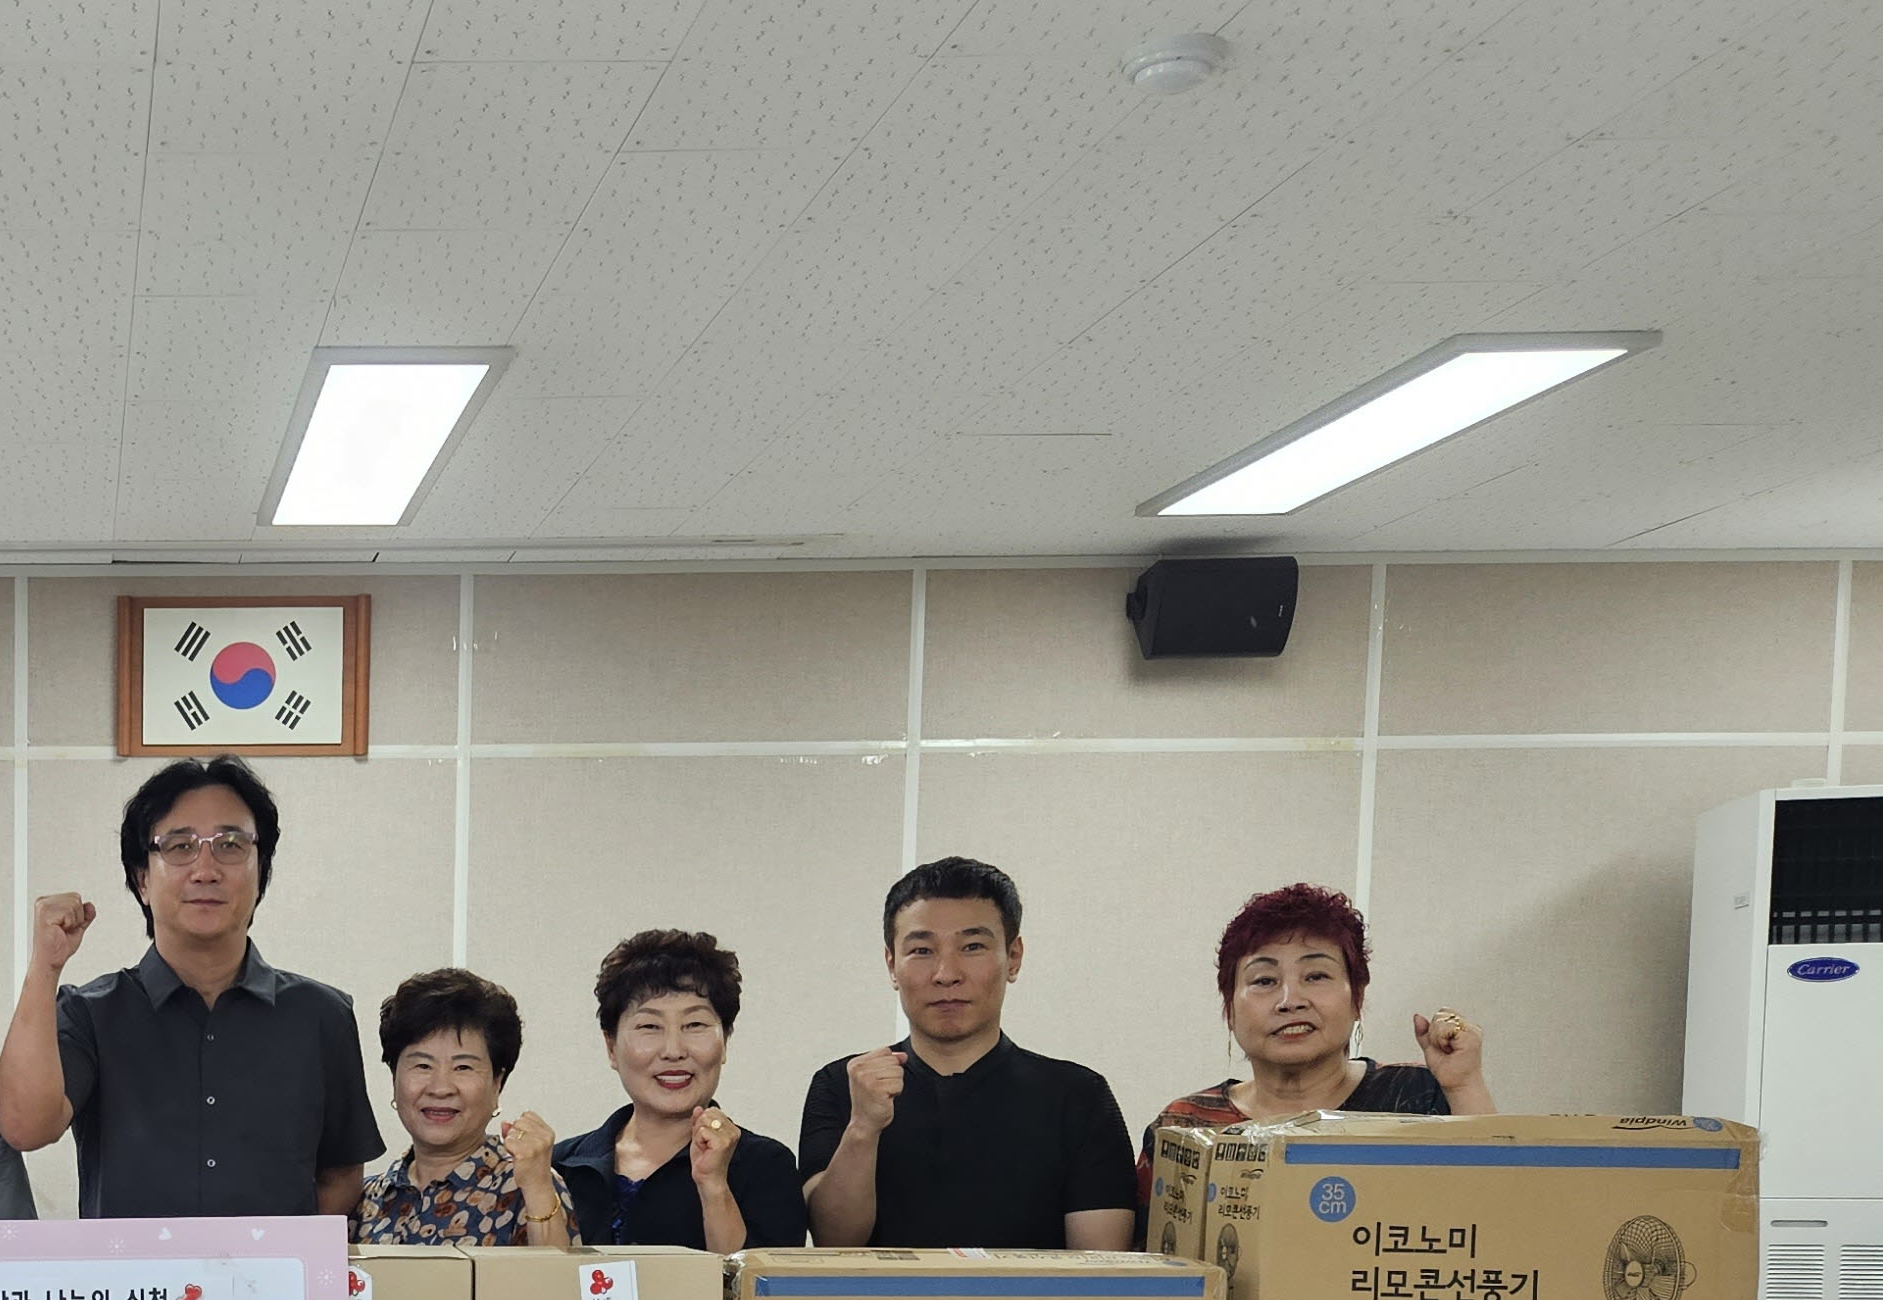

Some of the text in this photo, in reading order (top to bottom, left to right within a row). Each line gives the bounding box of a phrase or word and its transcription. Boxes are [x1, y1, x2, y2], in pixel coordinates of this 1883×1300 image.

[1797, 964, 1850, 976] Carrier
[1620, 1116, 1687, 1127] Windpia
[1321, 1183, 1345, 1200] 35
[1318, 1199, 1346, 1214] cm
[1352, 1222, 1476, 1257] 이코노미
